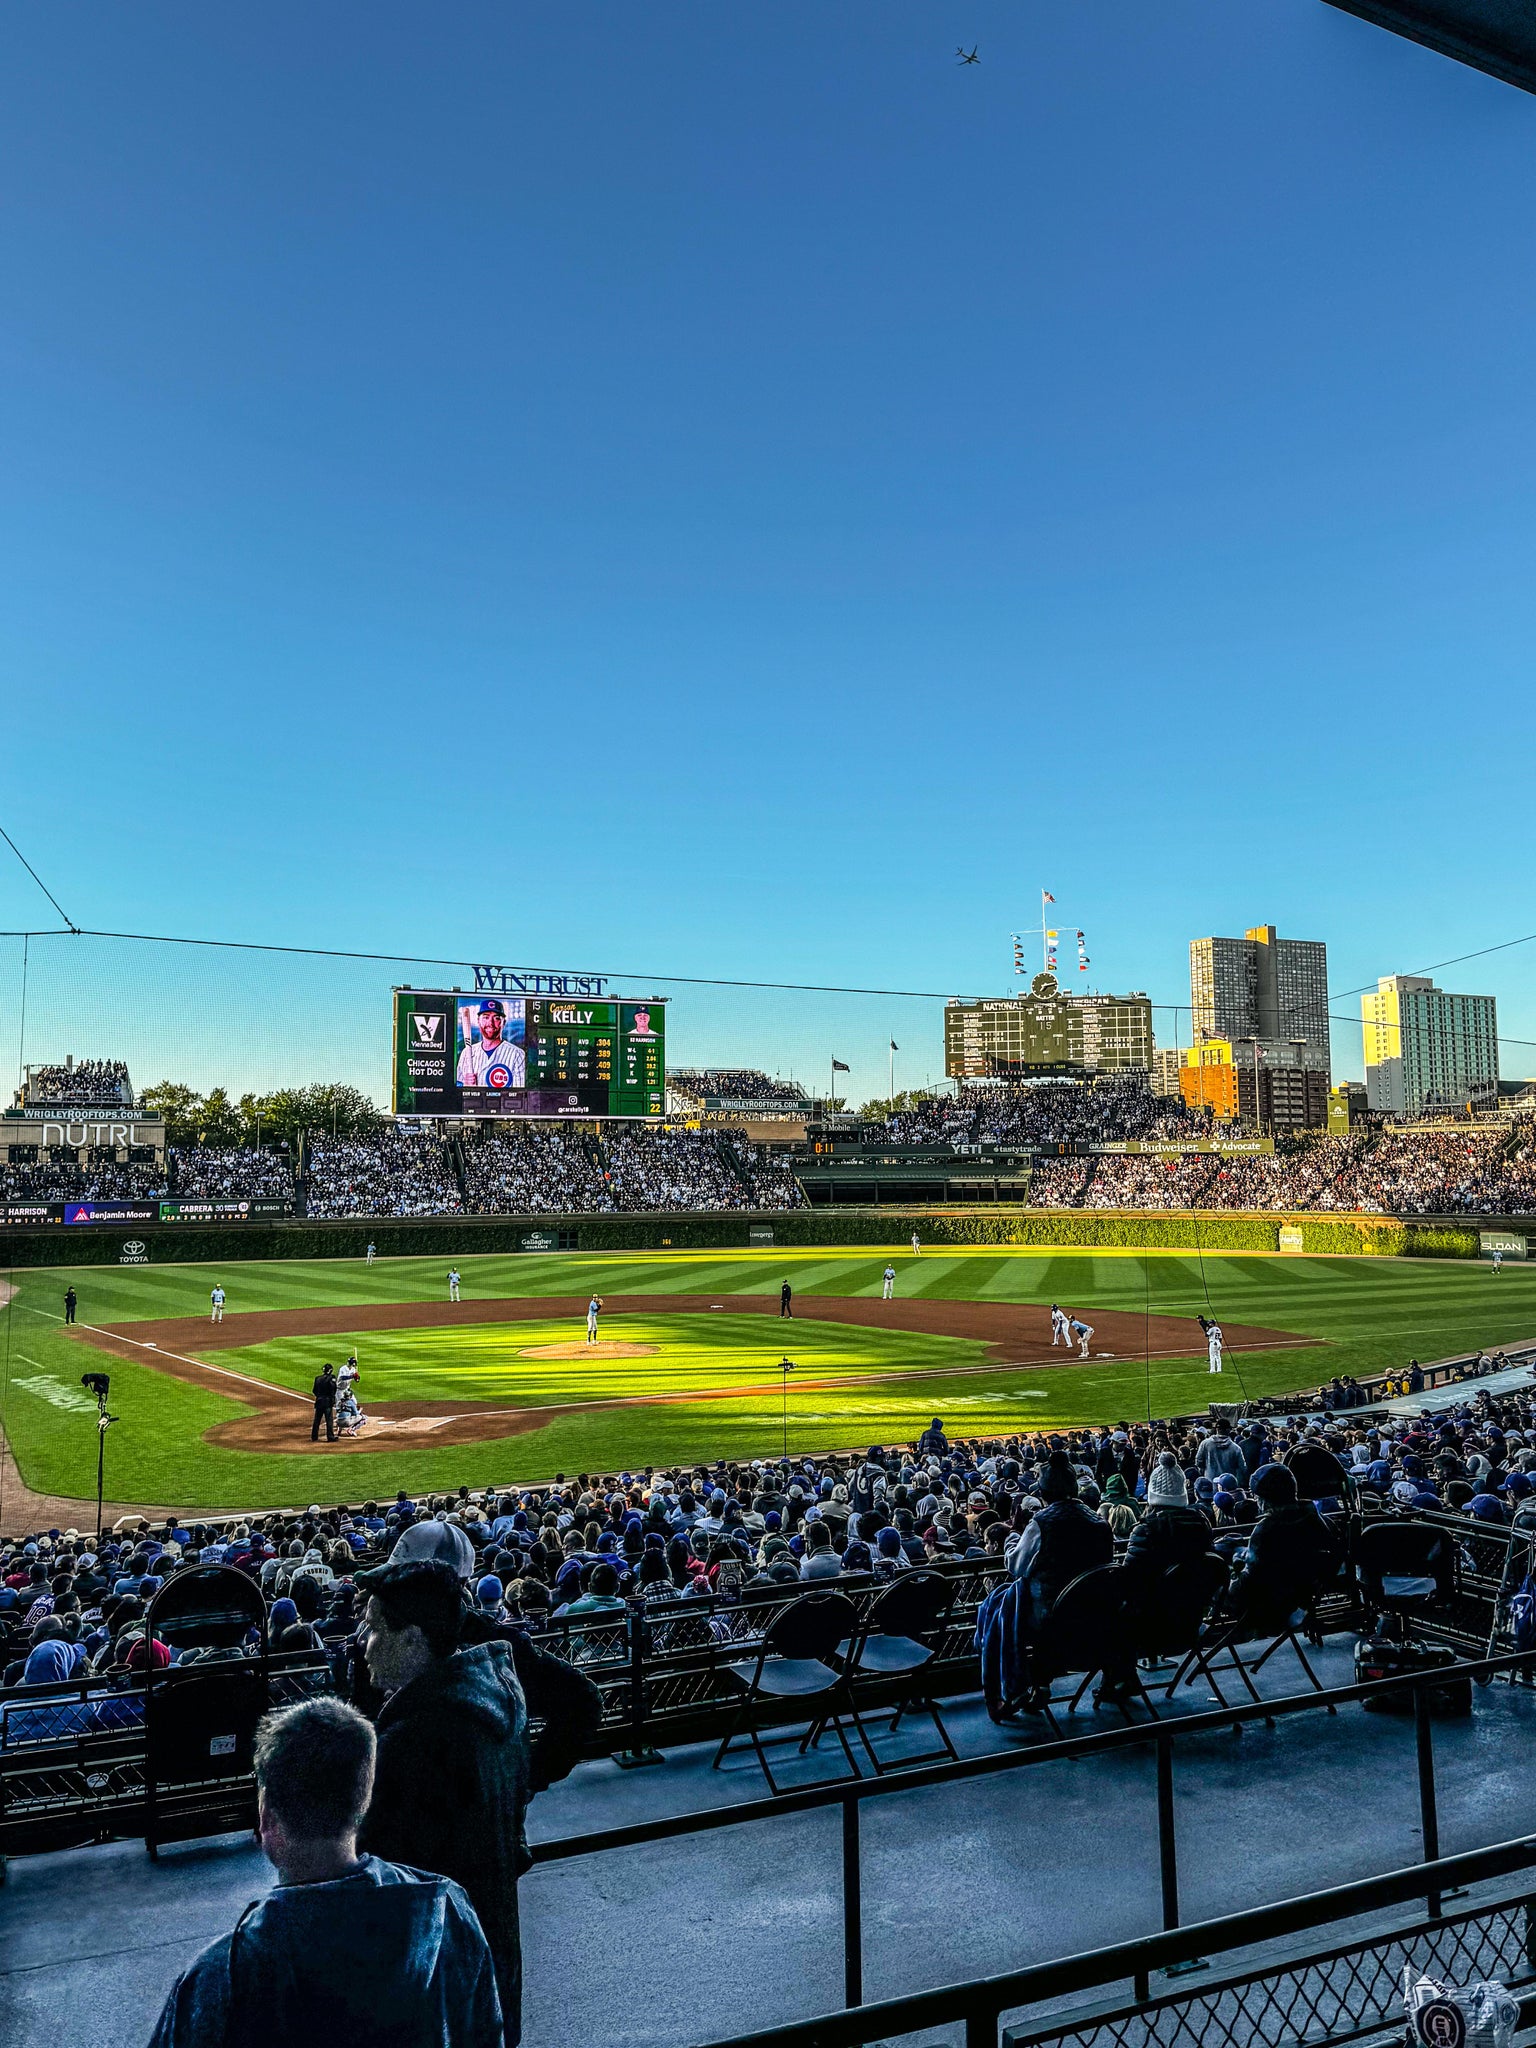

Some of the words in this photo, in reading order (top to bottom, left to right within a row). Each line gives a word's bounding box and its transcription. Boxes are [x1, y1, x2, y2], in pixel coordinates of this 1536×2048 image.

[472, 966, 608, 996] WINTRUST
[532, 1001, 540, 1010] 15
[550, 1002, 576, 1012] Carson
[983, 1002, 1024, 1011] NATIONAL
[552, 1011, 593, 1024] KELLY
[1041, 1022, 1052, 1030] 15
[407, 1058, 446, 1067] CHICAGO'S
[409, 1068, 425, 1076] HOT
[427, 1068, 443, 1076] DOG
[650, 1103, 661, 1112] 22
[720, 1100, 799, 1108] WRIGLEYROOFTOPS.COM
[24, 1110, 142, 1119] WRIGLEYROOFTOPS.COM
[815, 1143, 833, 1153] 0:11
[952, 1144, 982, 1154] YETI
[999, 1144, 1042, 1154] tastytrade
[1221, 1142, 1261, 1151] Advocate
[1481, 1242, 1521, 1251] SLOAN
